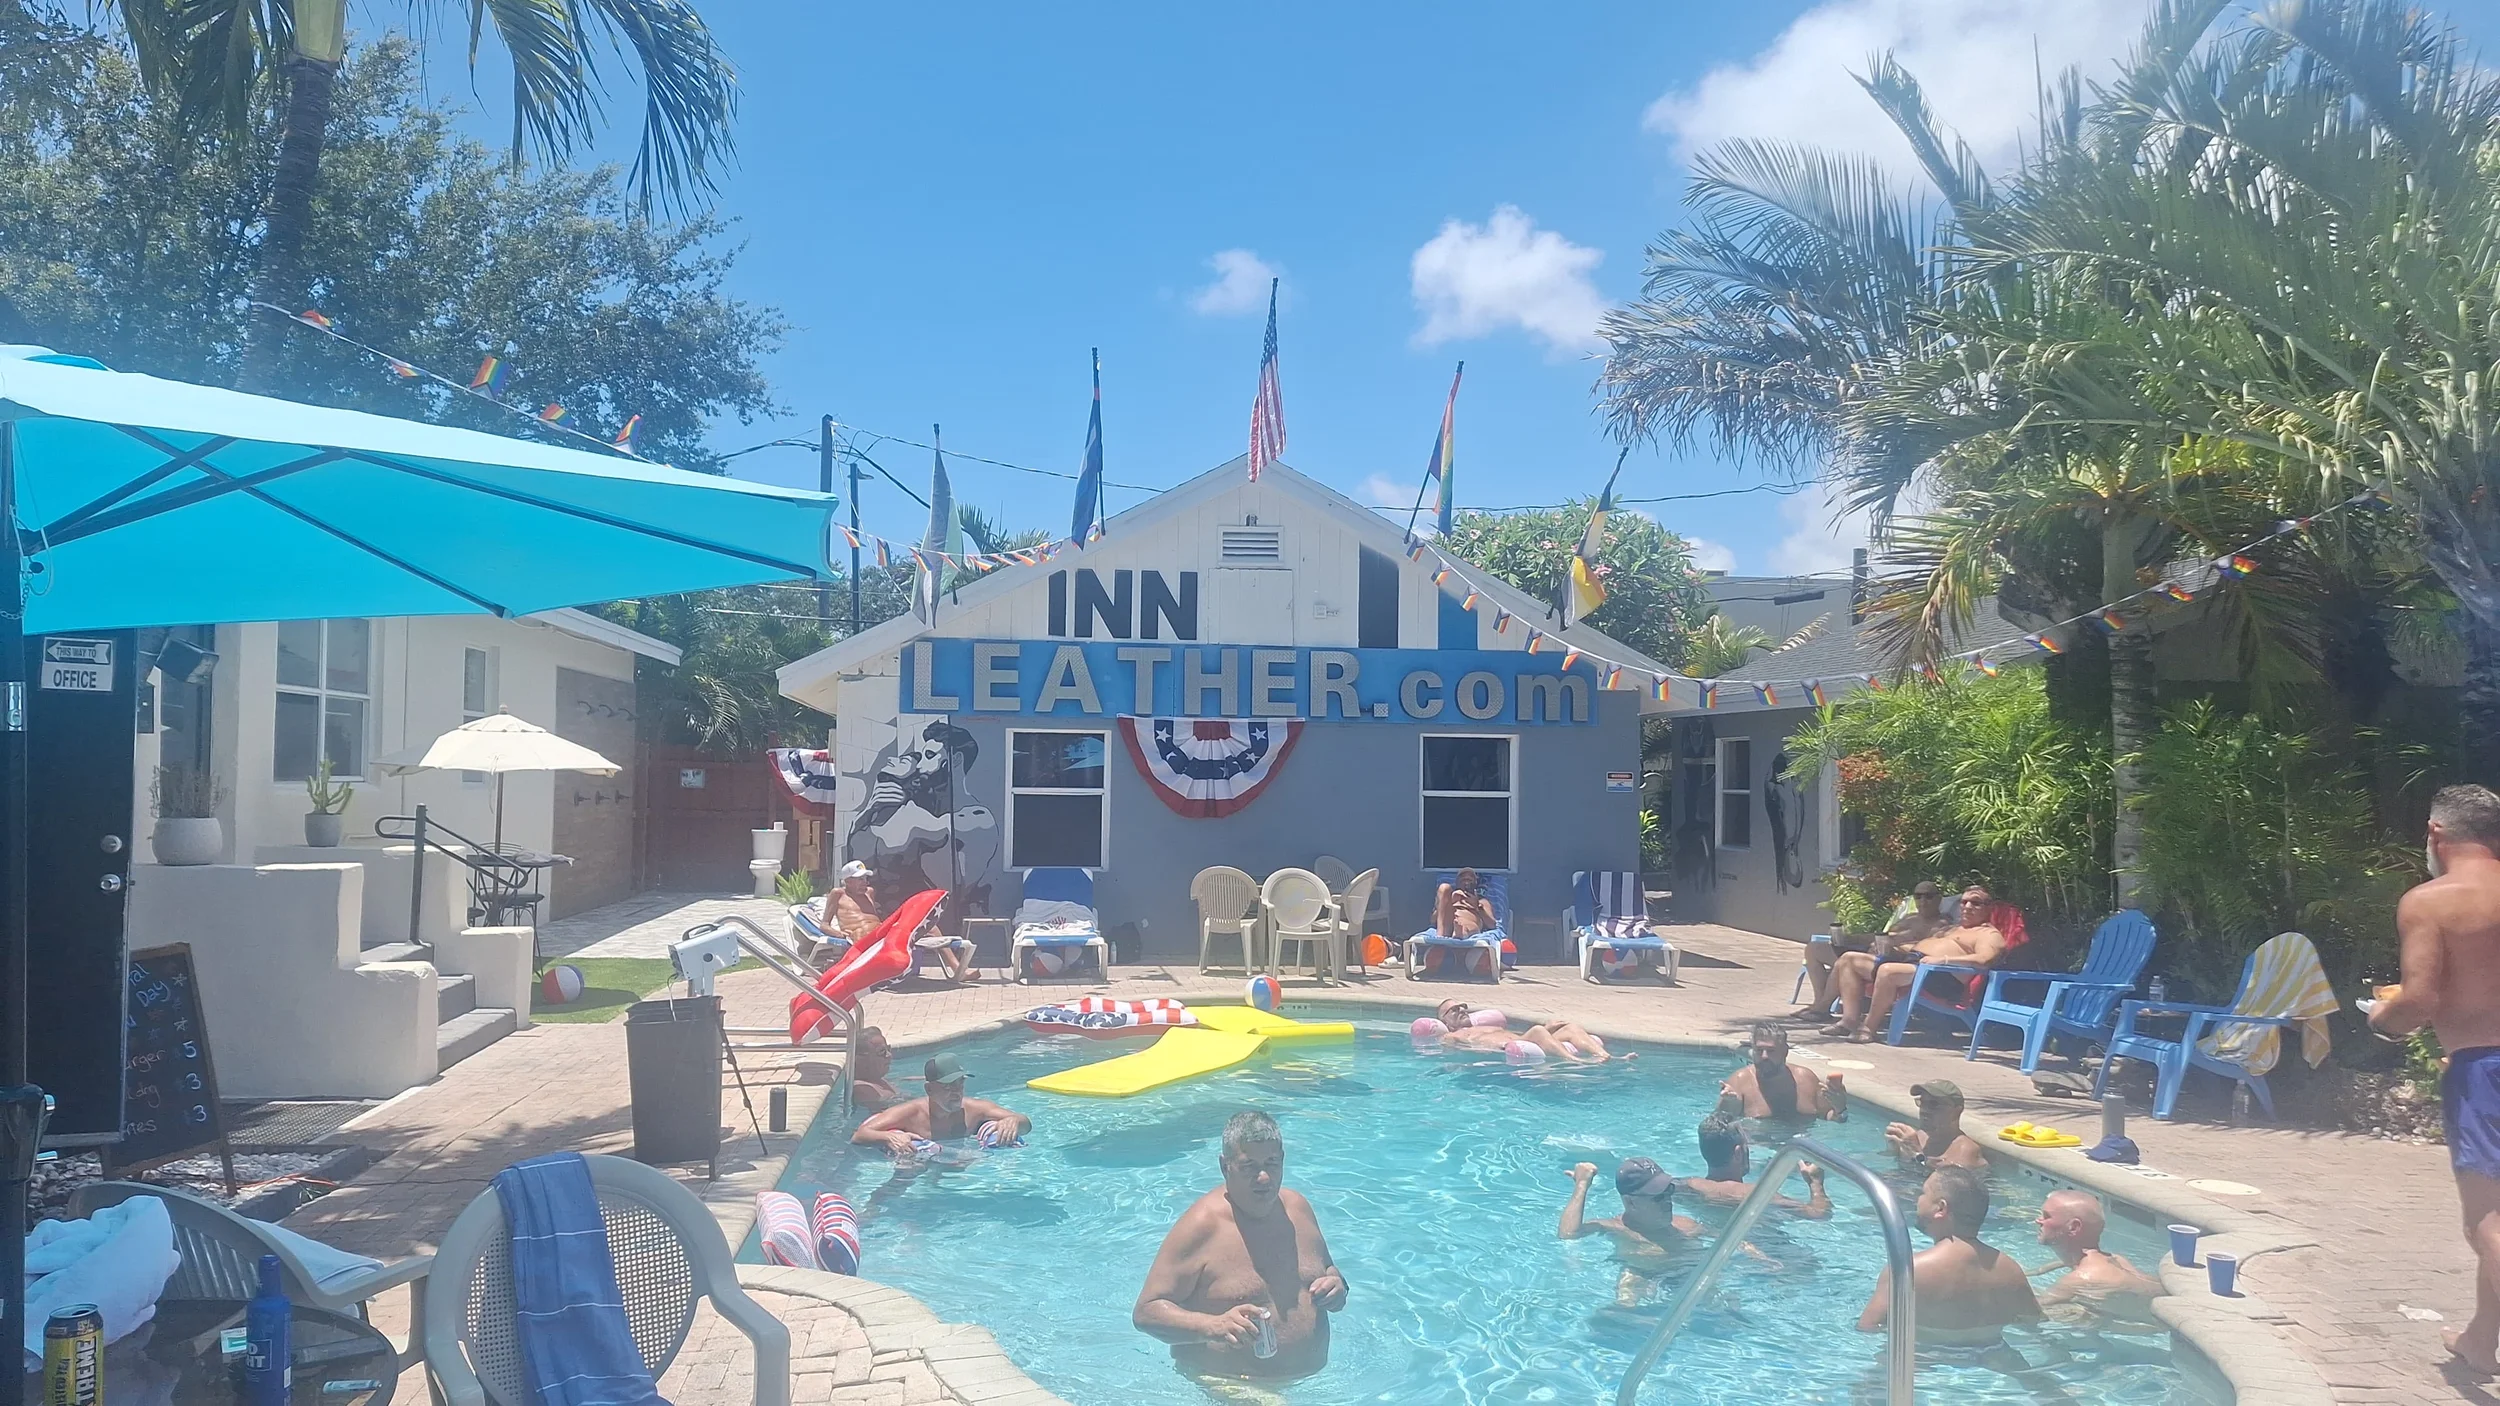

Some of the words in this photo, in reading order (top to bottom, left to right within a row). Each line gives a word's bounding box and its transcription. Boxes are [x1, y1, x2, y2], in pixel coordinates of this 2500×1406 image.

[1048, 568, 1198, 641] INN
[56, 646, 71, 657] THIS
[72, 648, 86, 657] WAY
[88, 649, 97, 658] TO
[53, 668, 97, 689] OFFICE
[135, 980, 171, 1008] Day
